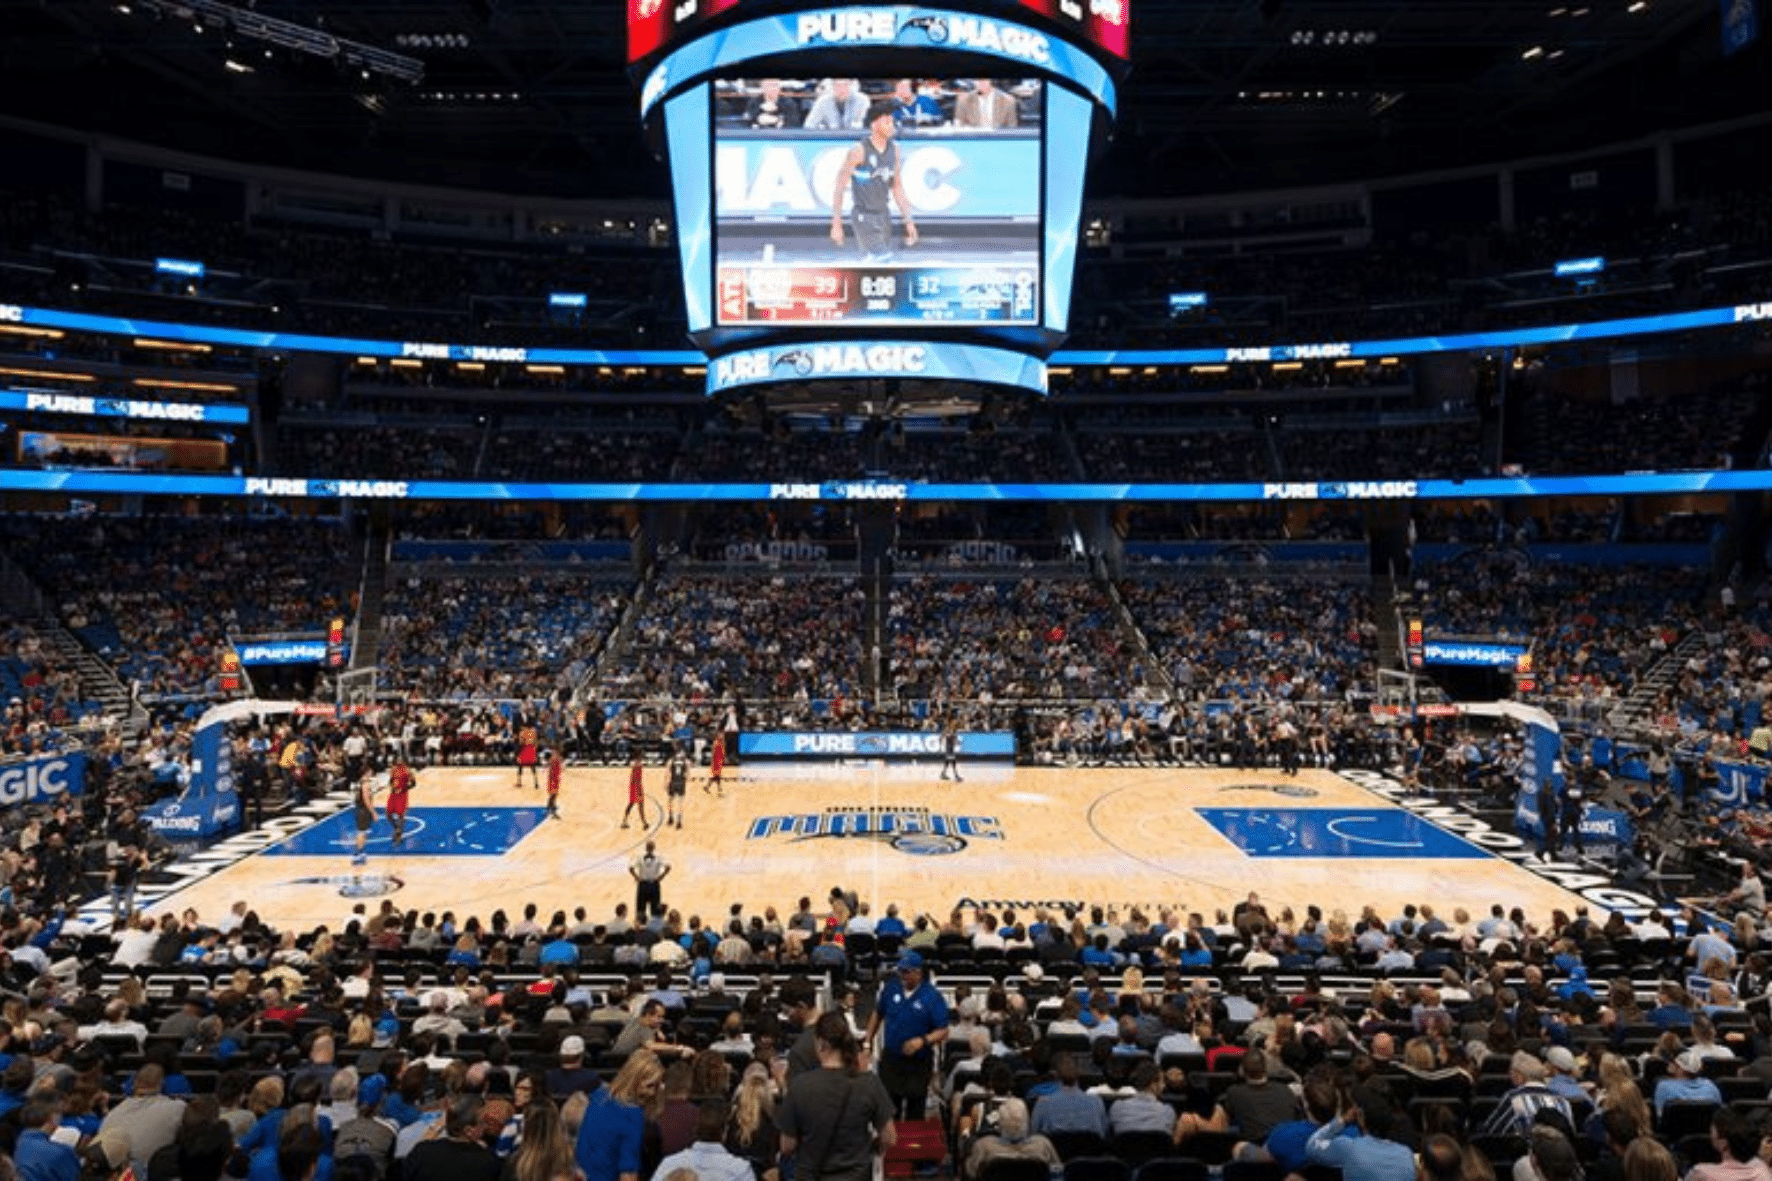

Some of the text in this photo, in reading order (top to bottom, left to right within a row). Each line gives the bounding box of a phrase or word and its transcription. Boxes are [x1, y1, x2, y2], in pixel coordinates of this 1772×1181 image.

[797, 11, 1049, 62] PURE MAGIC
[403, 343, 527, 361] PURE MAGIC
[1226, 343, 1351, 361] PURE MAGIC
[717, 346, 925, 384] PURE MAGIC
[27, 394, 204, 420] PURE MAGIC
[245, 479, 407, 497] PURE MAGIC
[769, 483, 907, 499] PURE MAGIC
[1263, 482, 1417, 498] PURE MAGIC
[795, 735, 854, 751] PURE
